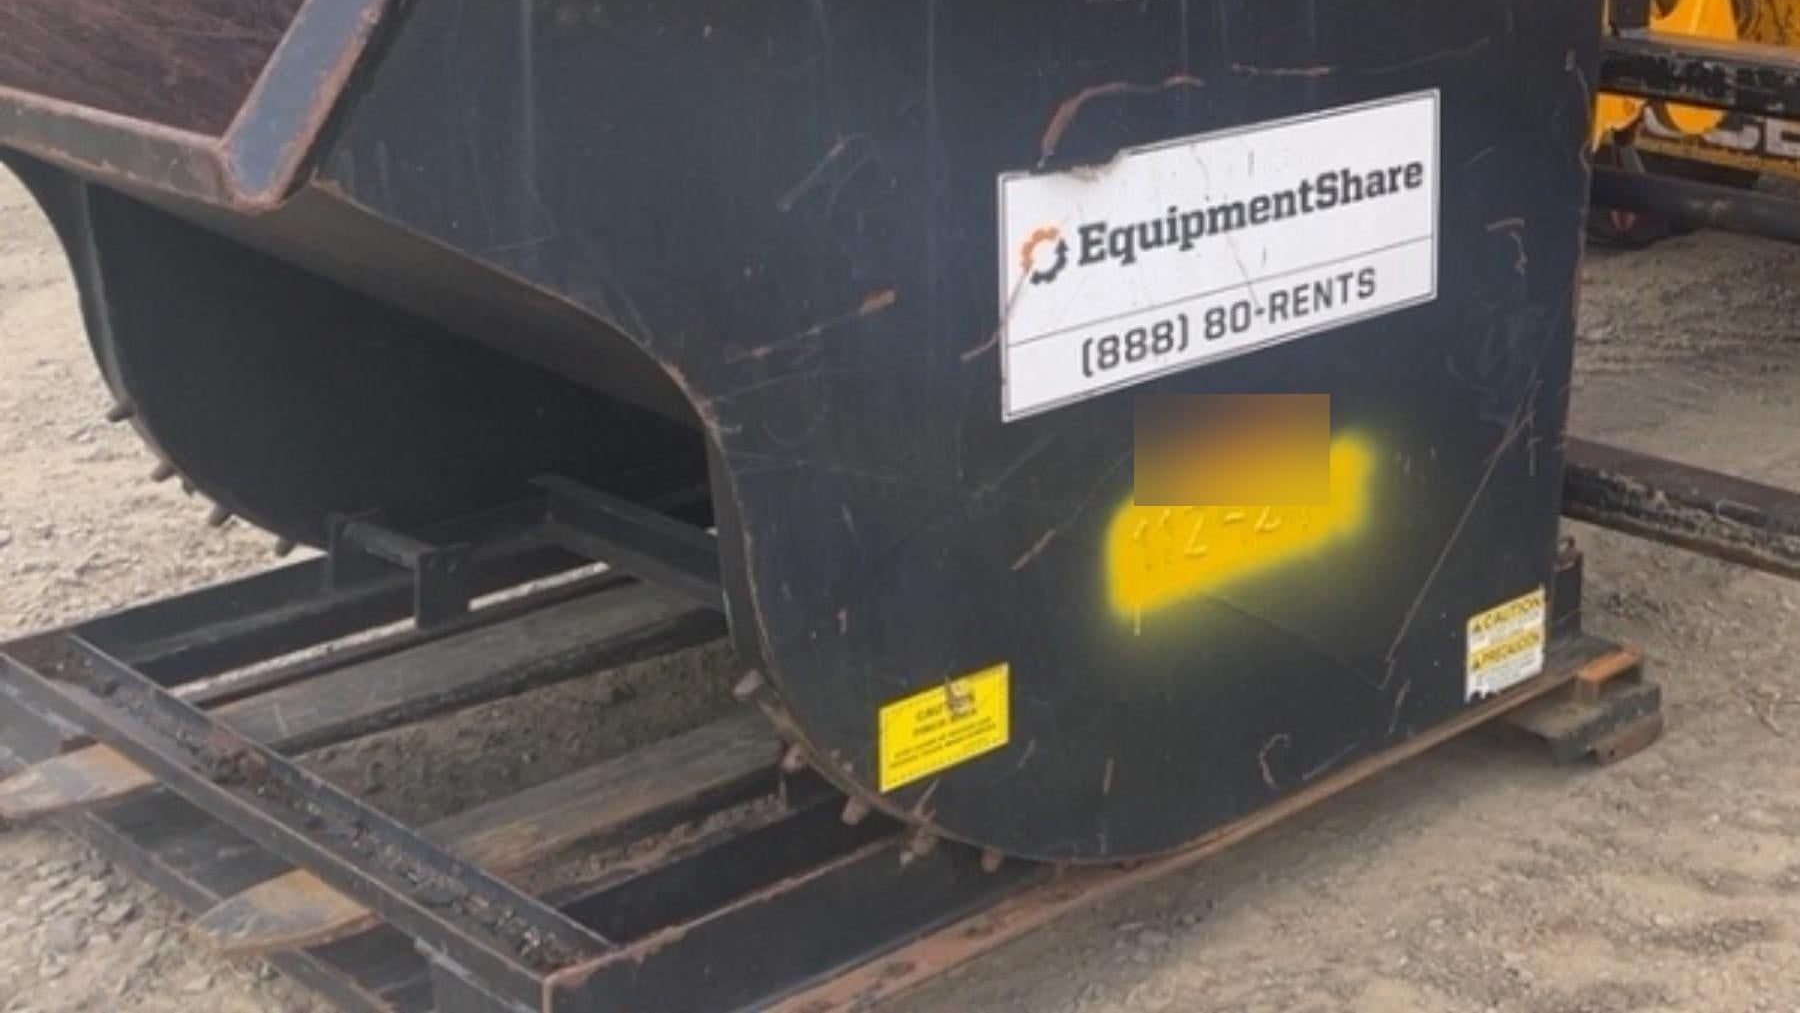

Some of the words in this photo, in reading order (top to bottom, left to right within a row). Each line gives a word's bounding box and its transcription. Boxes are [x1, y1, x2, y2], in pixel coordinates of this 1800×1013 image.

[1076, 159, 1425, 267] EquipmentShare
[1081, 312, 1190, 379] (888)
[1204, 266, 1378, 342] 80-RENTS
